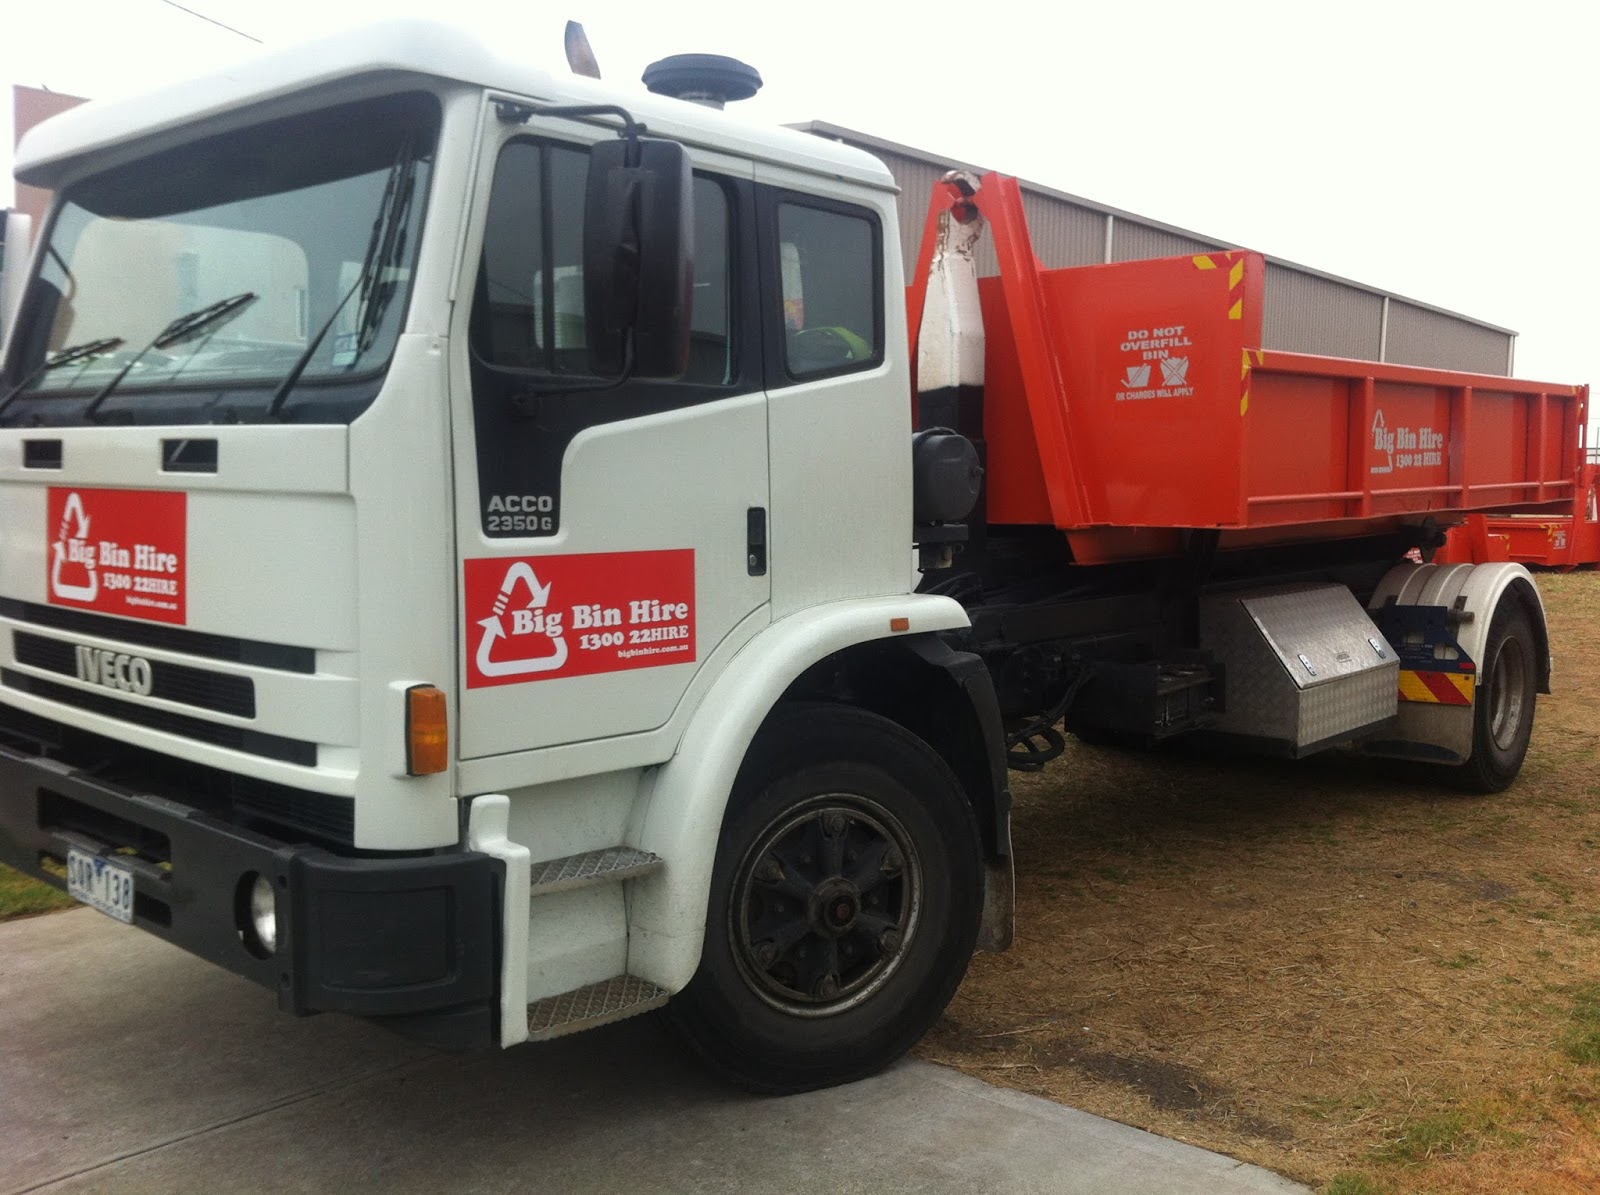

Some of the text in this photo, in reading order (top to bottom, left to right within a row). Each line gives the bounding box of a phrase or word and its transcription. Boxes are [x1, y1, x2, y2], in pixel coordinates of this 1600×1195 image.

[1128, 326, 1184, 340] DO NOT
[1120, 337, 1192, 351] OVERFILL
[1143, 350, 1169, 360] BIN
[1116, 392, 1126, 400] OR
[1156, 388, 1172, 398] WILL
[1173, 387, 1194, 396] APPLY
[1375, 427, 1443, 454] Big Bin Hire
[488, 495, 552, 512] ACCO
[488, 516, 552, 531] 2350 G
[68, 538, 177, 573] Big Bin Hire
[103, 572, 178, 595] 1300 22HIRE
[512, 600, 688, 637] Big Bin Hire
[580, 625, 688, 650] 1300 22HIRE
[618, 644, 689, 658] bigbinhire.com.au
[75, 645, 152, 696] IVECO
